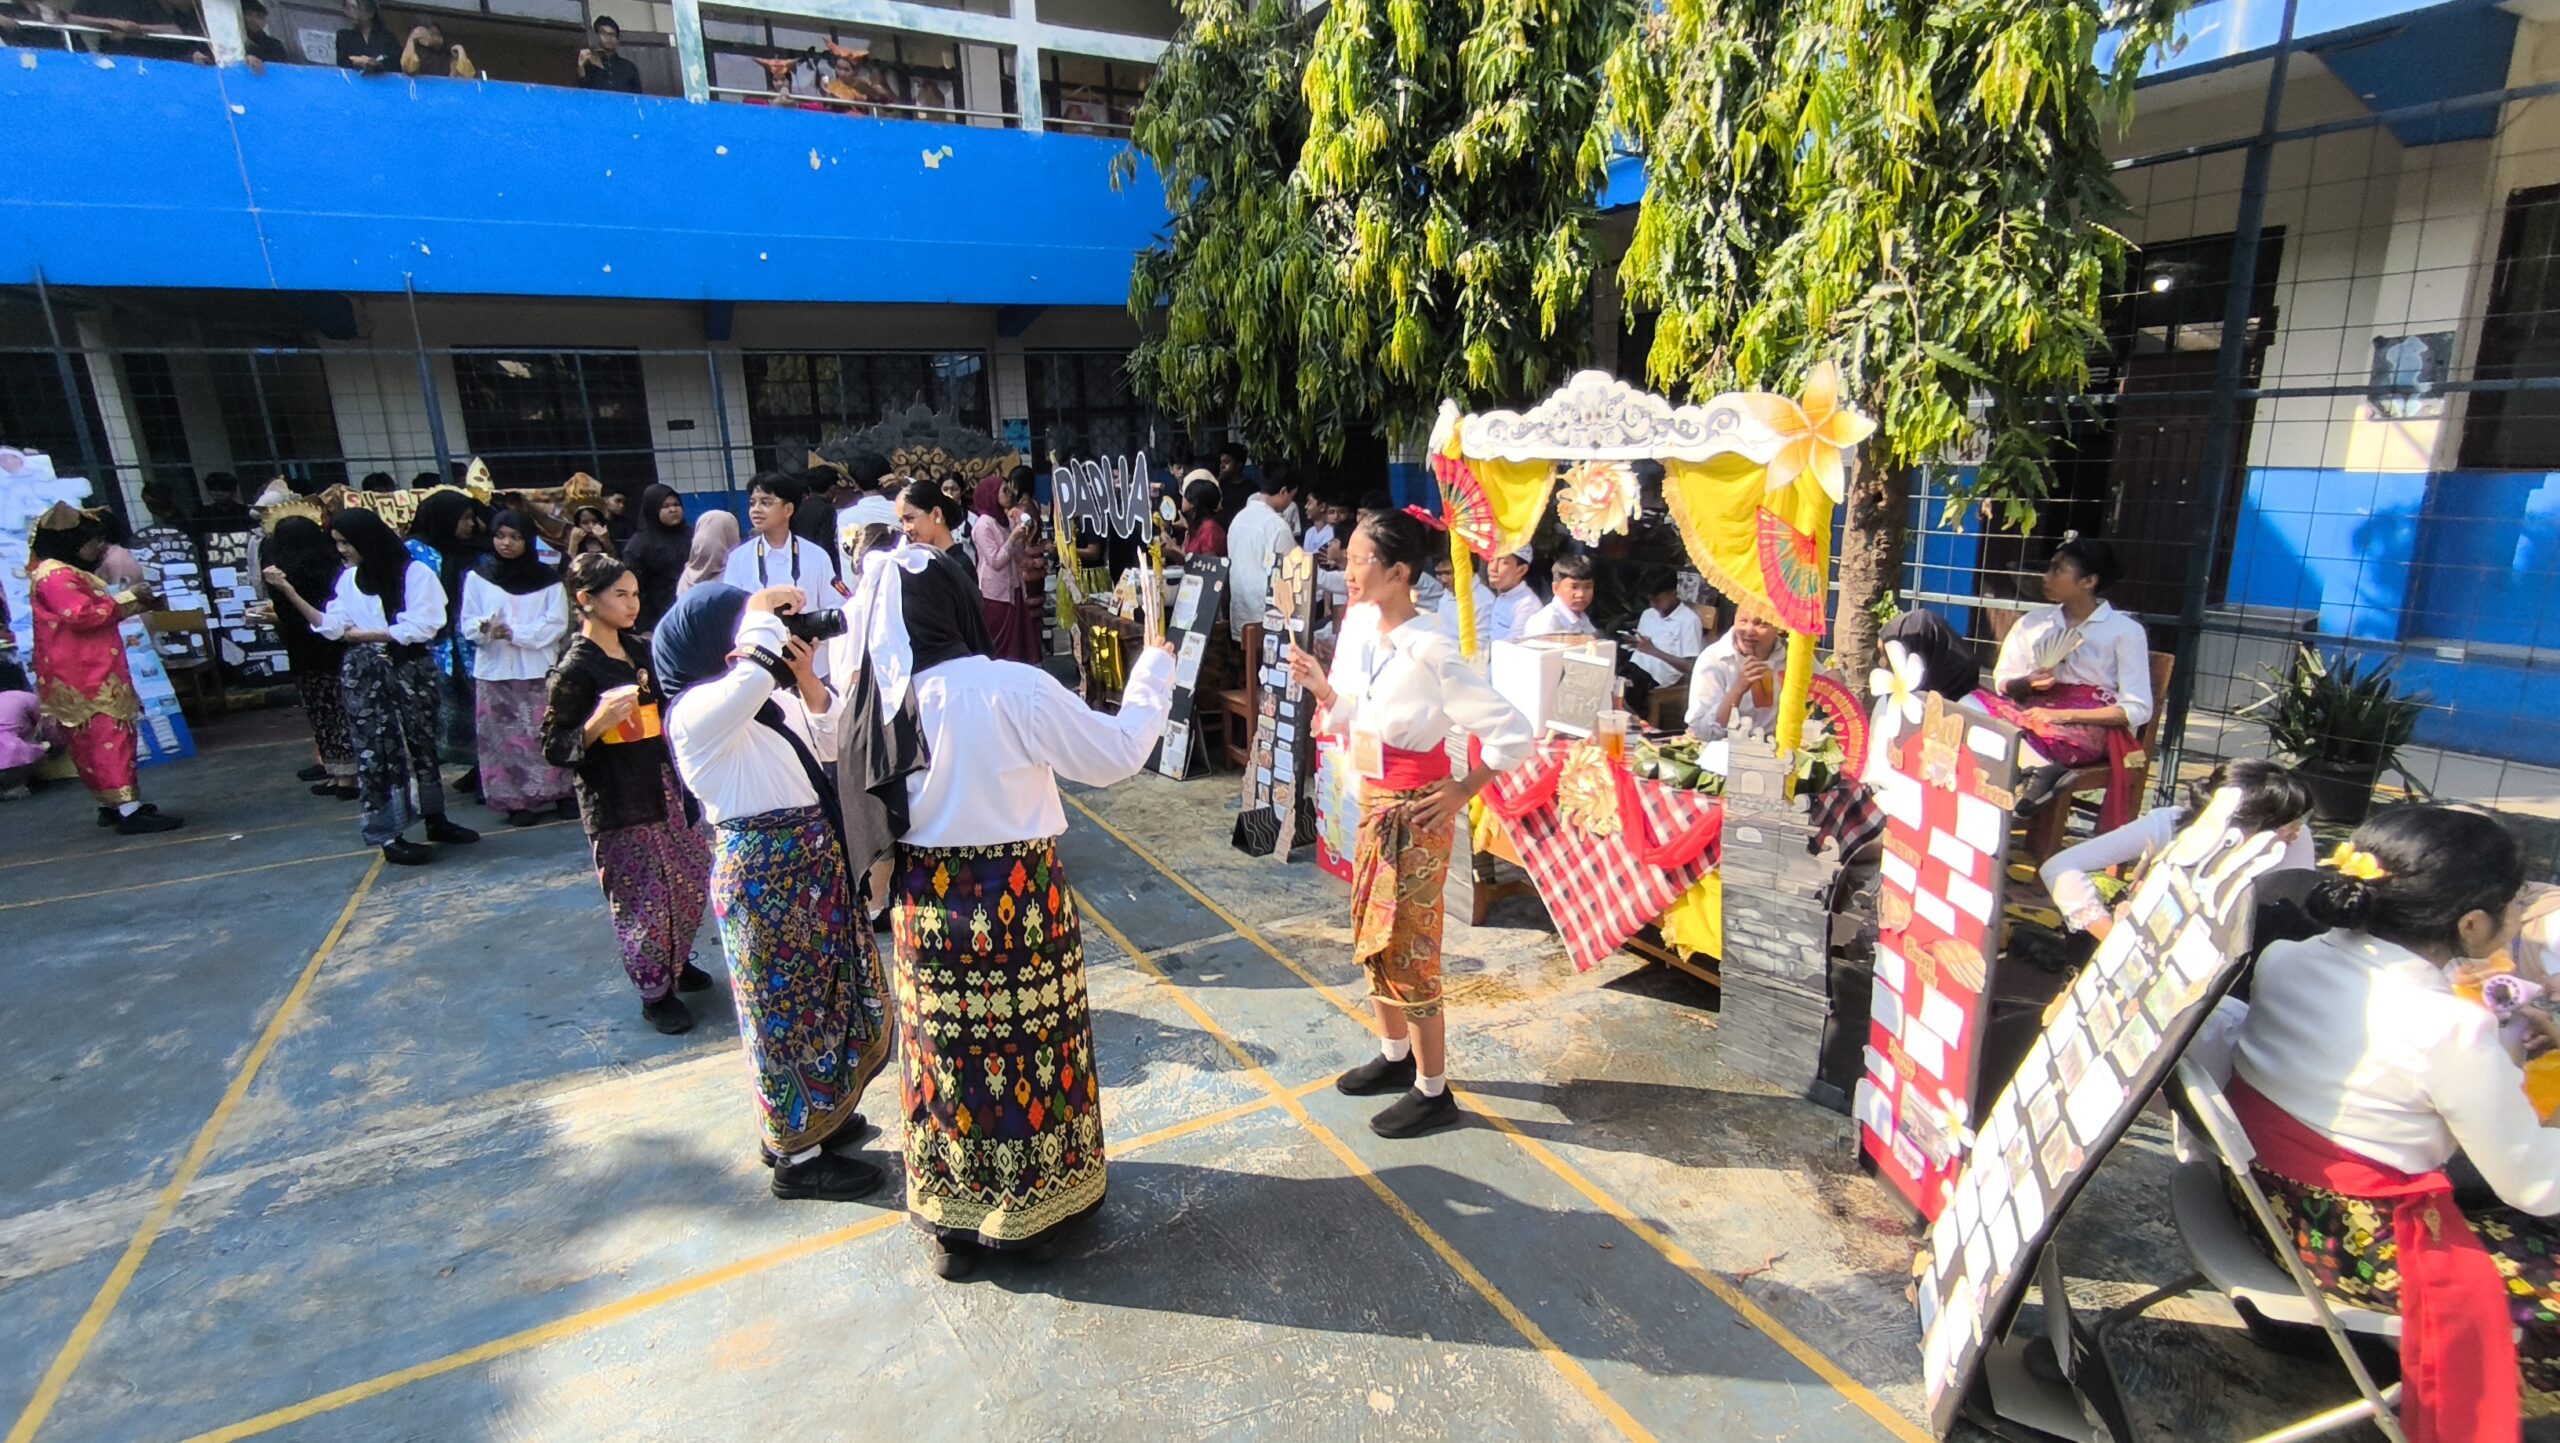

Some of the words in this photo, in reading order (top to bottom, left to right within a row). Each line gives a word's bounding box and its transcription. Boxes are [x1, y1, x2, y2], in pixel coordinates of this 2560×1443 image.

[1053, 451, 1152, 544] PAPUA
[209, 532, 249, 549] JAW
[207, 547, 248, 564] BAR
